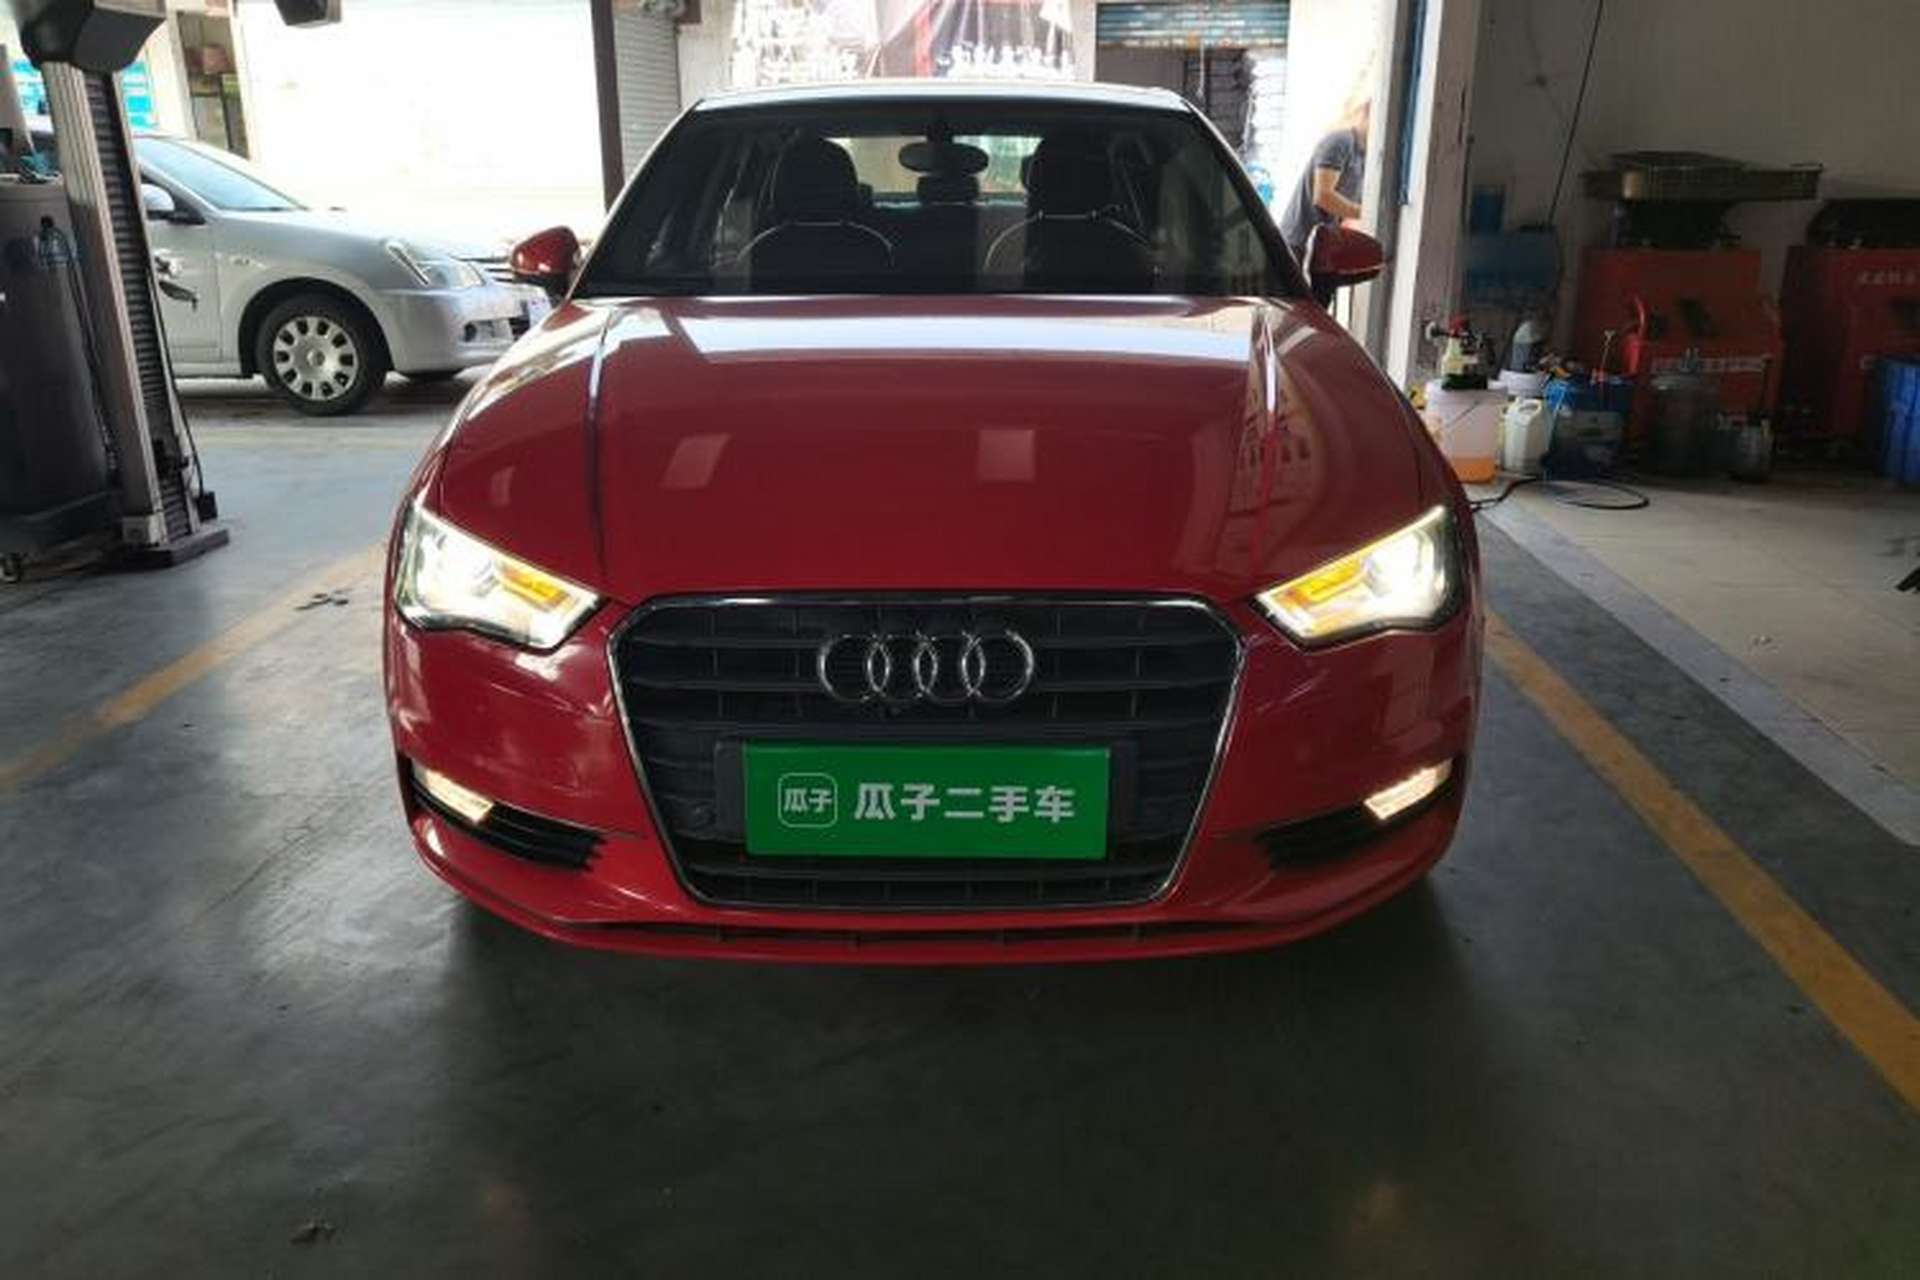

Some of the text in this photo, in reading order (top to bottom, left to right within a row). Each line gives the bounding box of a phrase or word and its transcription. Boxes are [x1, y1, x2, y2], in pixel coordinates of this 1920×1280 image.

[784, 788, 832, 813] 瓜子
[854, 783, 1075, 823] 瓜子二手车
